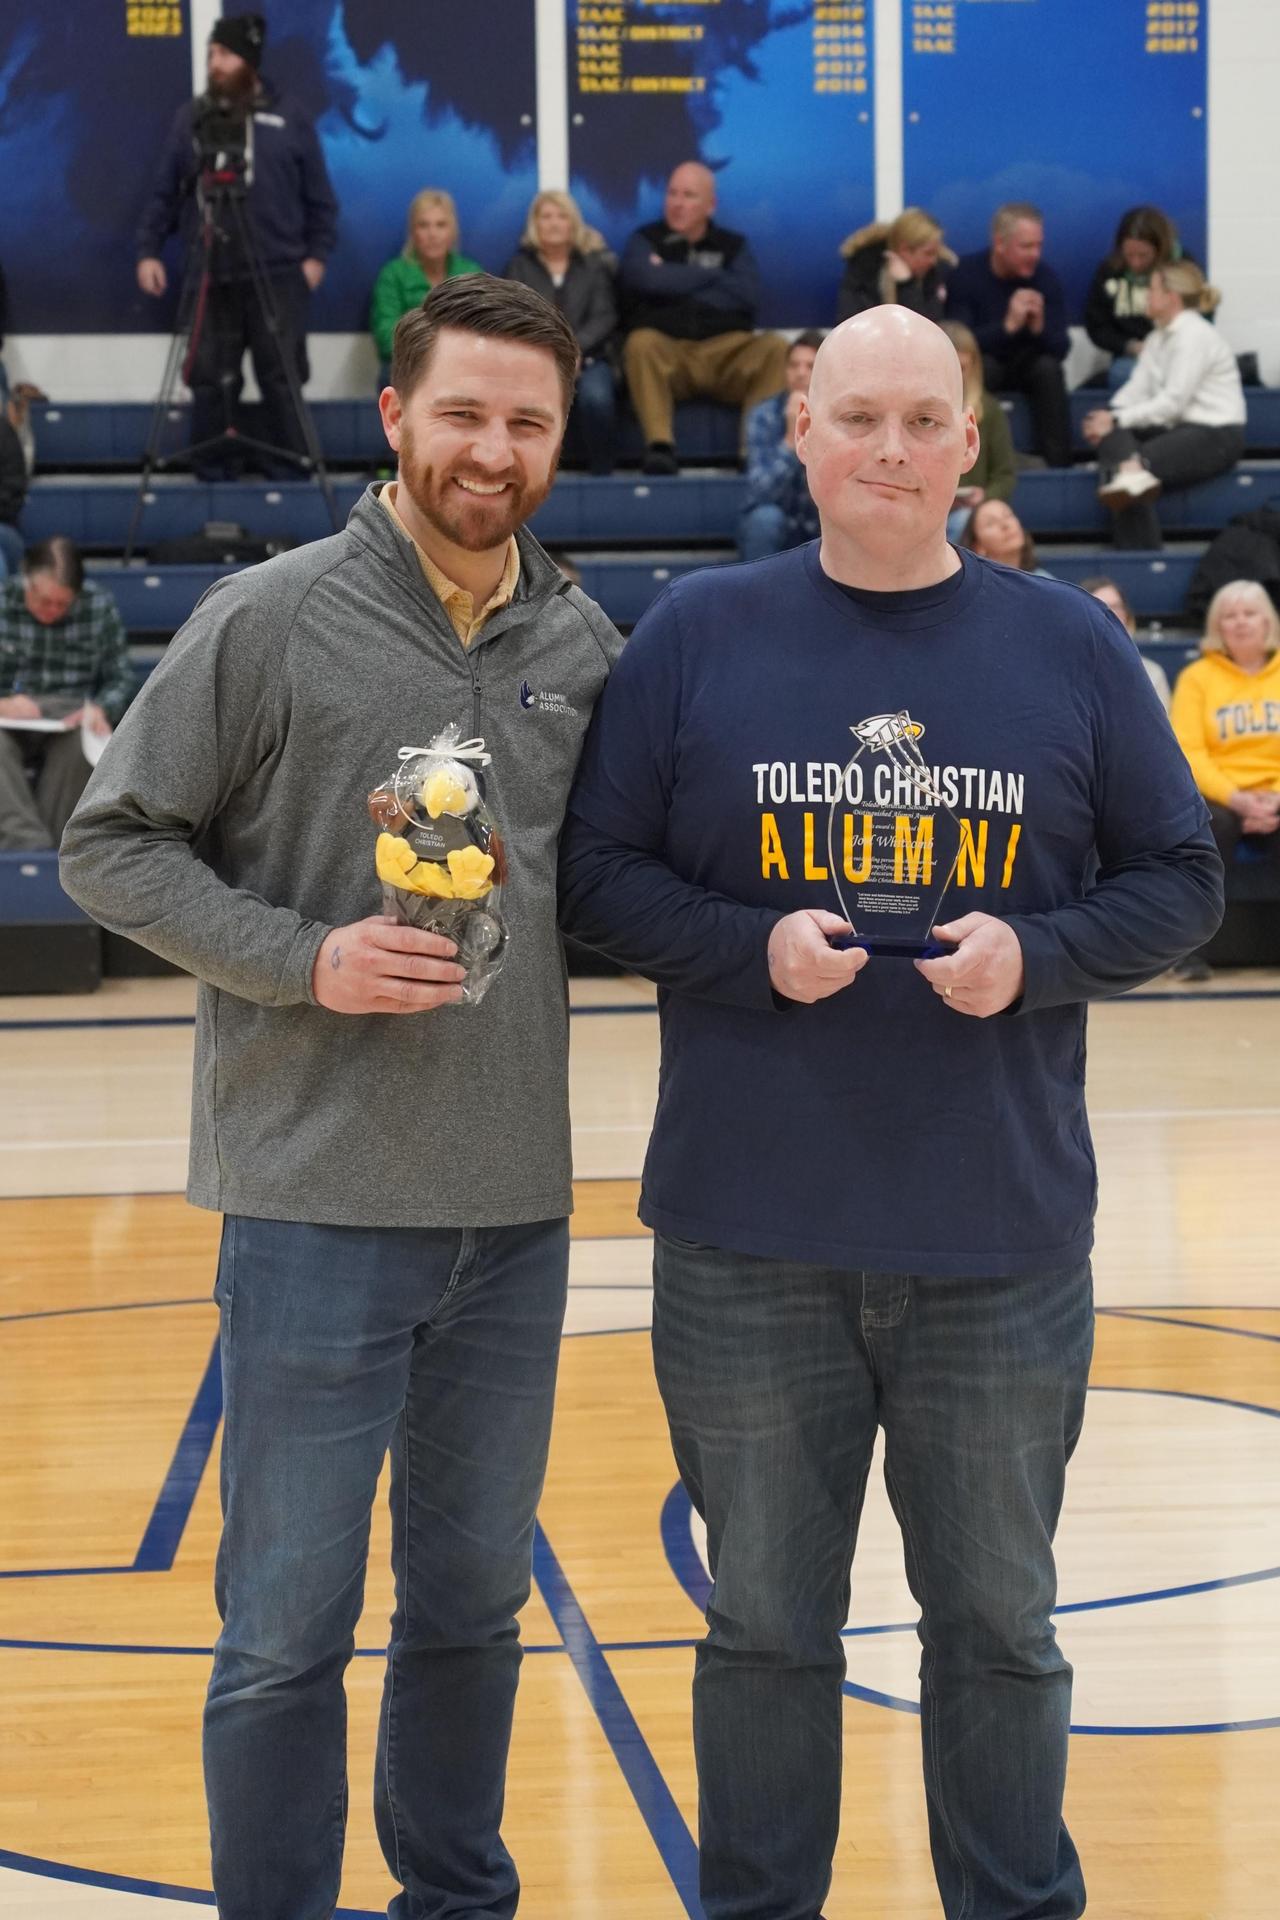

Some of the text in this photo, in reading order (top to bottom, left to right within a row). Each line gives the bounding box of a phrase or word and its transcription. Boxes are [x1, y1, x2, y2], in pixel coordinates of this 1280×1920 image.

[752, 762, 1025, 815] TOLEDO CHRISTIAN
[414, 838, 446, 848] CHRISTIAN
[419, 831, 444, 842] TOLEDO
[761, 812, 1022, 889] ALUMNI
